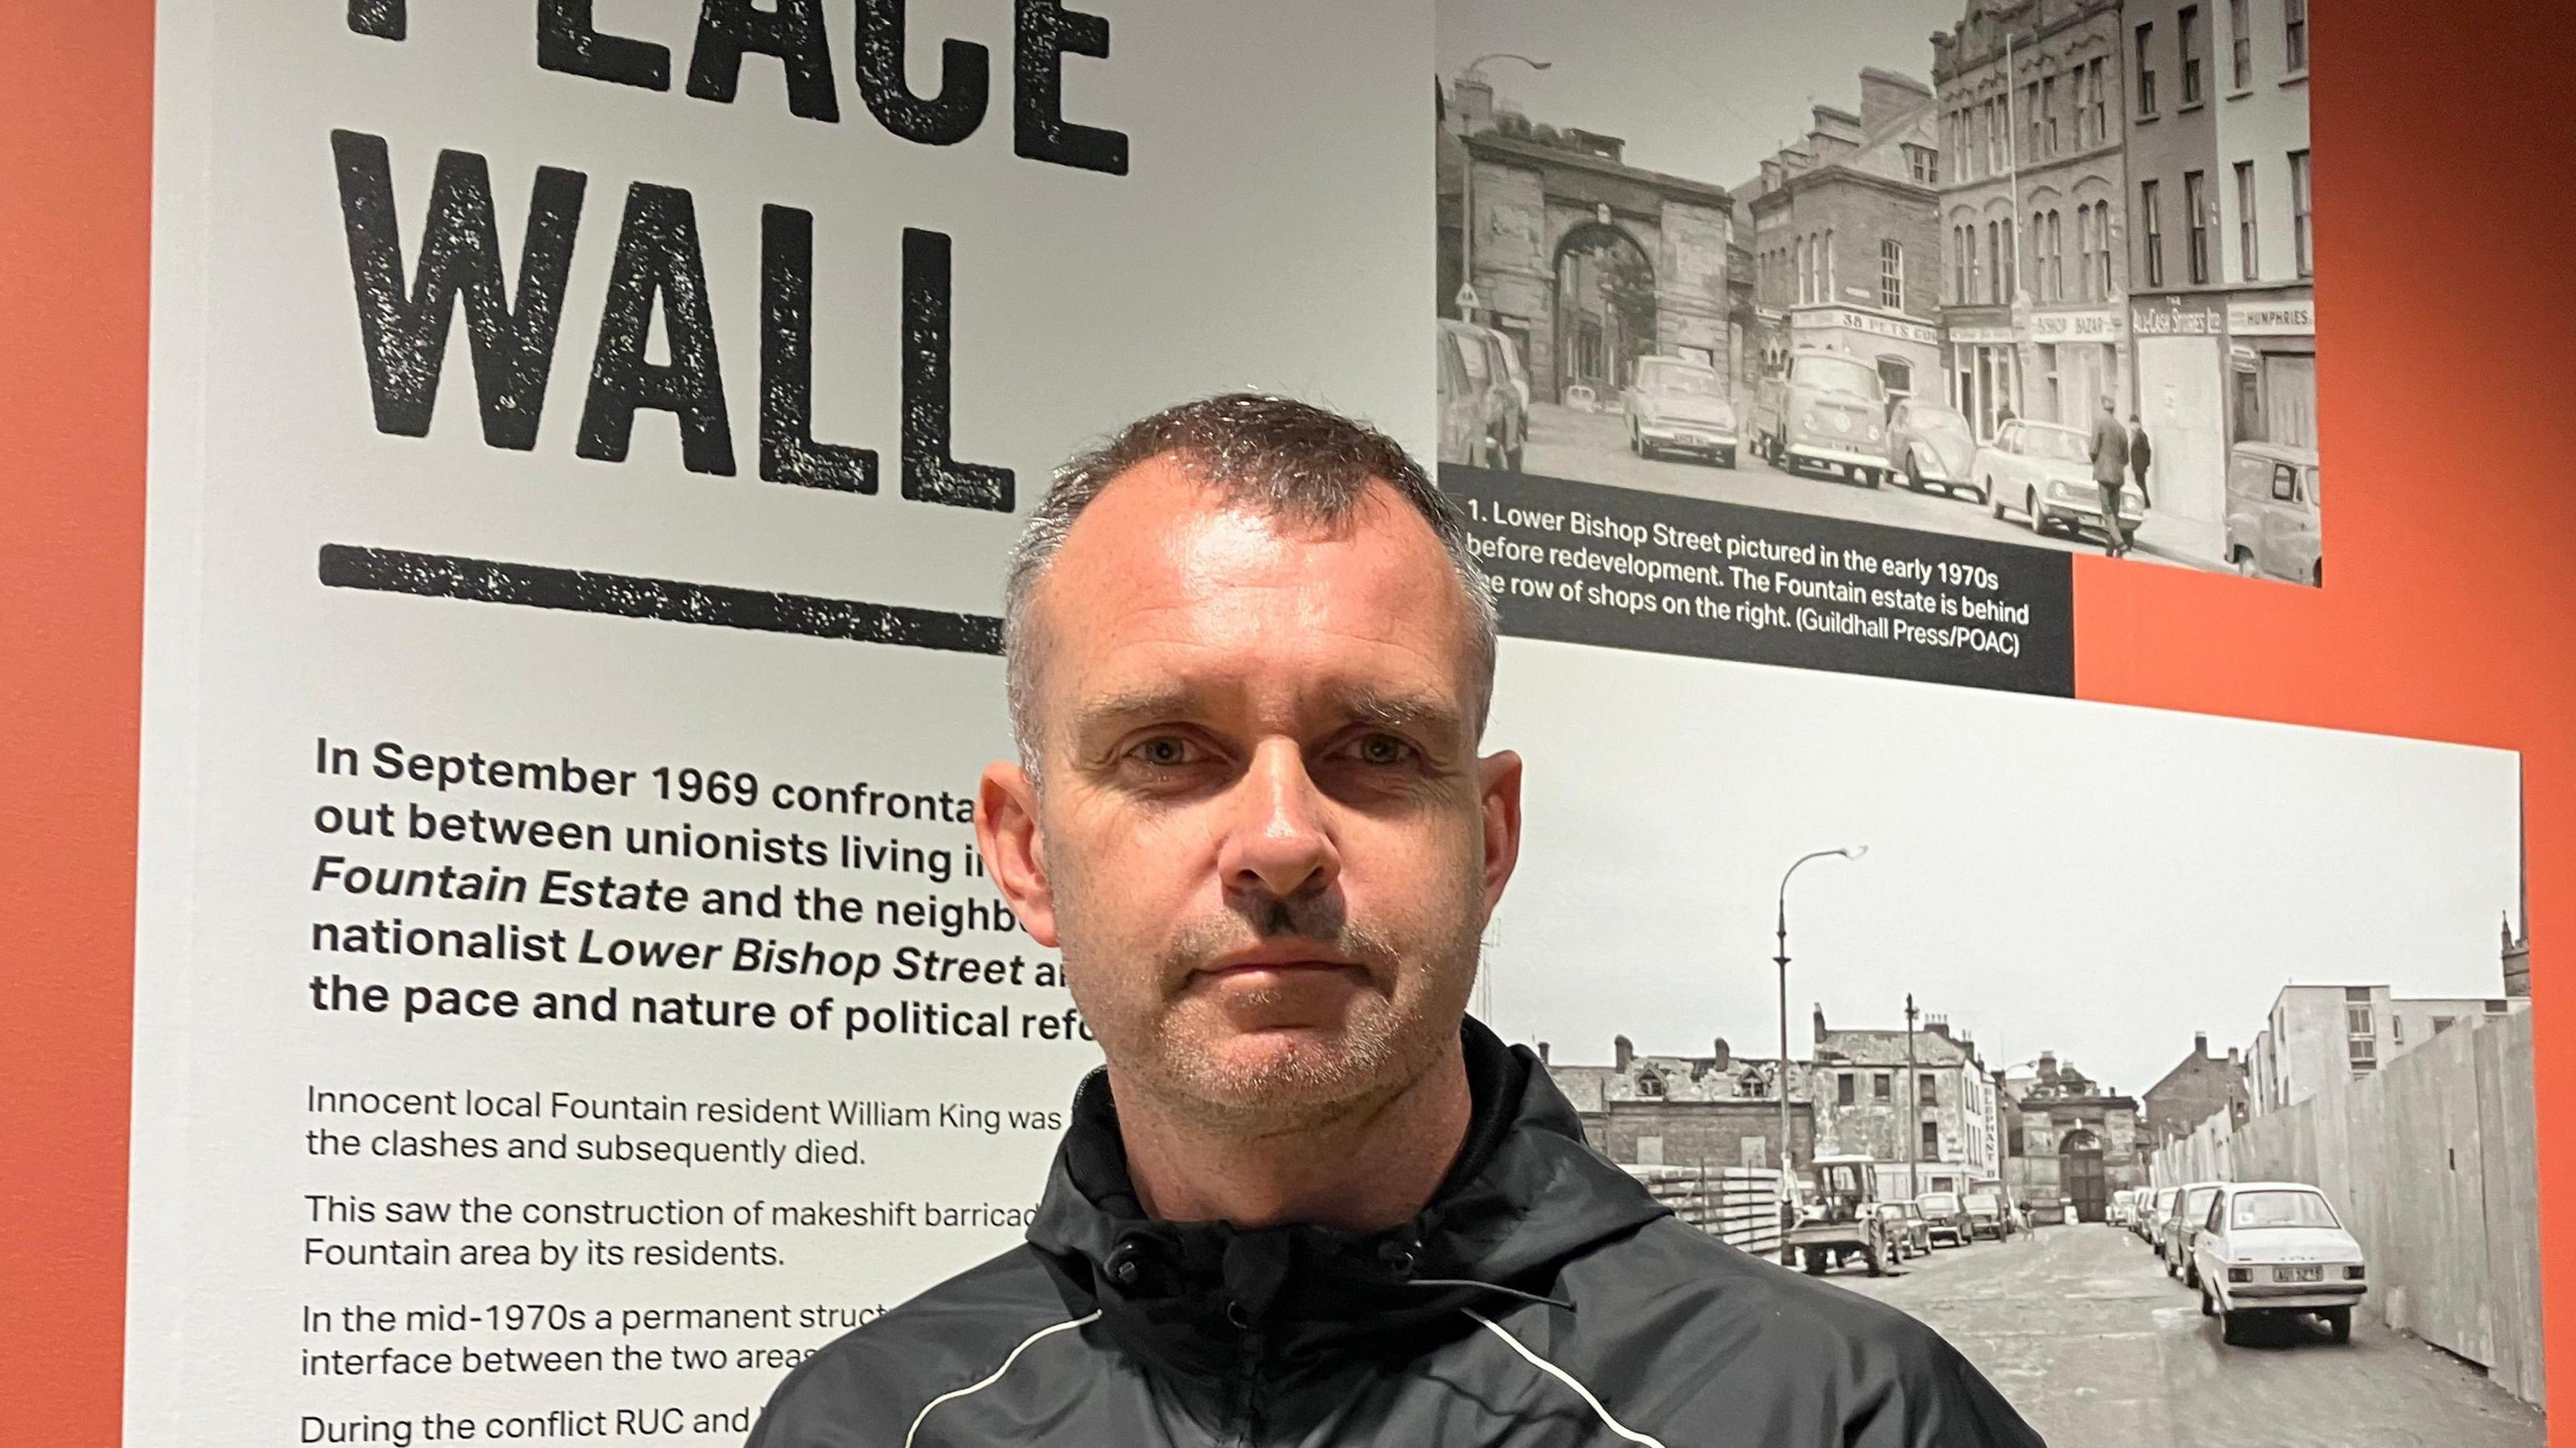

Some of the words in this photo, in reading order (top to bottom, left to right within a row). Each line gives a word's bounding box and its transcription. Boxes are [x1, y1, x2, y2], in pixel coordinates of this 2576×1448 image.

[331, 129, 1015, 513] WALL
[2247, 311, 2308, 325] HUMPHRIES
[1468, 499, 1487, 522] 1.
[1494, 501, 1565, 531] Lower
[1571, 512, 1648, 547] Bishop
[1654, 523, 1721, 553] Street
[1727, 535, 1815, 565] pictured
[1821, 545, 1838, 568] in
[1843, 550, 1877, 573] the
[1882, 559, 1932, 586] early
[1937, 563, 1998, 590] 1970s
[1465, 533, 1544, 563] before
[1550, 547, 1724, 586] redevelopment.
[1729, 566, 1770, 592] The
[1776, 572, 1866, 604] Fountain
[1871, 589, 1936, 613] estate
[1941, 593, 1957, 616] is
[1962, 596, 2029, 624] behind
[1511, 578, 1554, 598] row
[1559, 580, 1583, 602] of
[1588, 583, 1657, 614] shops
[1662, 596, 1690, 616] on
[1695, 596, 1731, 620] the
[1737, 601, 1792, 630] right.
[1796, 607, 1888, 638] (Guildhall
[1894, 619, 2019, 657] Press/POAC)
[317, 738, 358, 775] In
[374, 742, 637, 796] September
[653, 767, 757, 806] 1969
[315, 803, 394, 837] out
[410, 803, 610, 851] between
[627, 823, 827, 867] unionists
[842, 835, 951, 883] living
[312, 856, 527, 903] Fountain
[539, 870, 688, 912] Estate
[702, 885, 781, 918] and
[794, 887, 863, 923] the
[877, 895, 1027, 937] neighb
[313, 918, 566, 962] nationalist
[578, 930, 722, 969] Lower
[733, 938, 880, 985] Bishop
[894, 947, 1024, 985] Street
[309, 974, 388, 1012] the
[405, 987, 519, 1022] pace
[533, 987, 616, 1021] and
[633, 993, 775, 1028] nature
[790, 997, 833, 1030] of
[847, 1001, 1008, 1040] political
[309, 1085, 456, 1115] Innocent
[467, 1090, 540, 1117] local
[552, 1093, 686, 1121] Fountain
[698, 1098, 820, 1124] resident
[828, 1101, 930, 1127] William
[941, 1103, 1000, 1134] King
[1008, 1111, 1061, 1129] was
[306, 1129, 360, 1156] the
[372, 1130, 498, 1158] clashes
[508, 1133, 566, 1159] and
[577, 1135, 786, 1169] subsequently
[796, 1139, 865, 1164] died.
[305, 1195, 375, 1222] This
[386, 1203, 451, 1222] saw
[460, 1197, 512, 1223] the
[523, 1199, 723, 1225] construction
[734, 1201, 765, 1225] of
[773, 1201, 916, 1226] makeshift
[305, 1238, 449, 1265] Fountain
[460, 1245, 529, 1265] area
[541, 1239, 578, 1271] by
[588, 1239, 623, 1265] its
[635, 1240, 784, 1265] residents.
[304, 1306, 331, 1332] In
[341, 1305, 396, 1332] the
[407, 1304, 585, 1331] mid-1970s
[596, 1311, 611, 1329] a
[623, 1304, 791, 1335] permanent
[303, 1347, 451, 1376] interface
[463, 1347, 602, 1373] between
[612, 1345, 662, 1370] the
[672, 1346, 727, 1370] two
[302, 1415, 411, 1447] During
[422, 1413, 475, 1440] the
[486, 1410, 606, 1438] conflict
[617, 1408, 684, 1435] RUC
[694, 1407, 749, 1433] and
